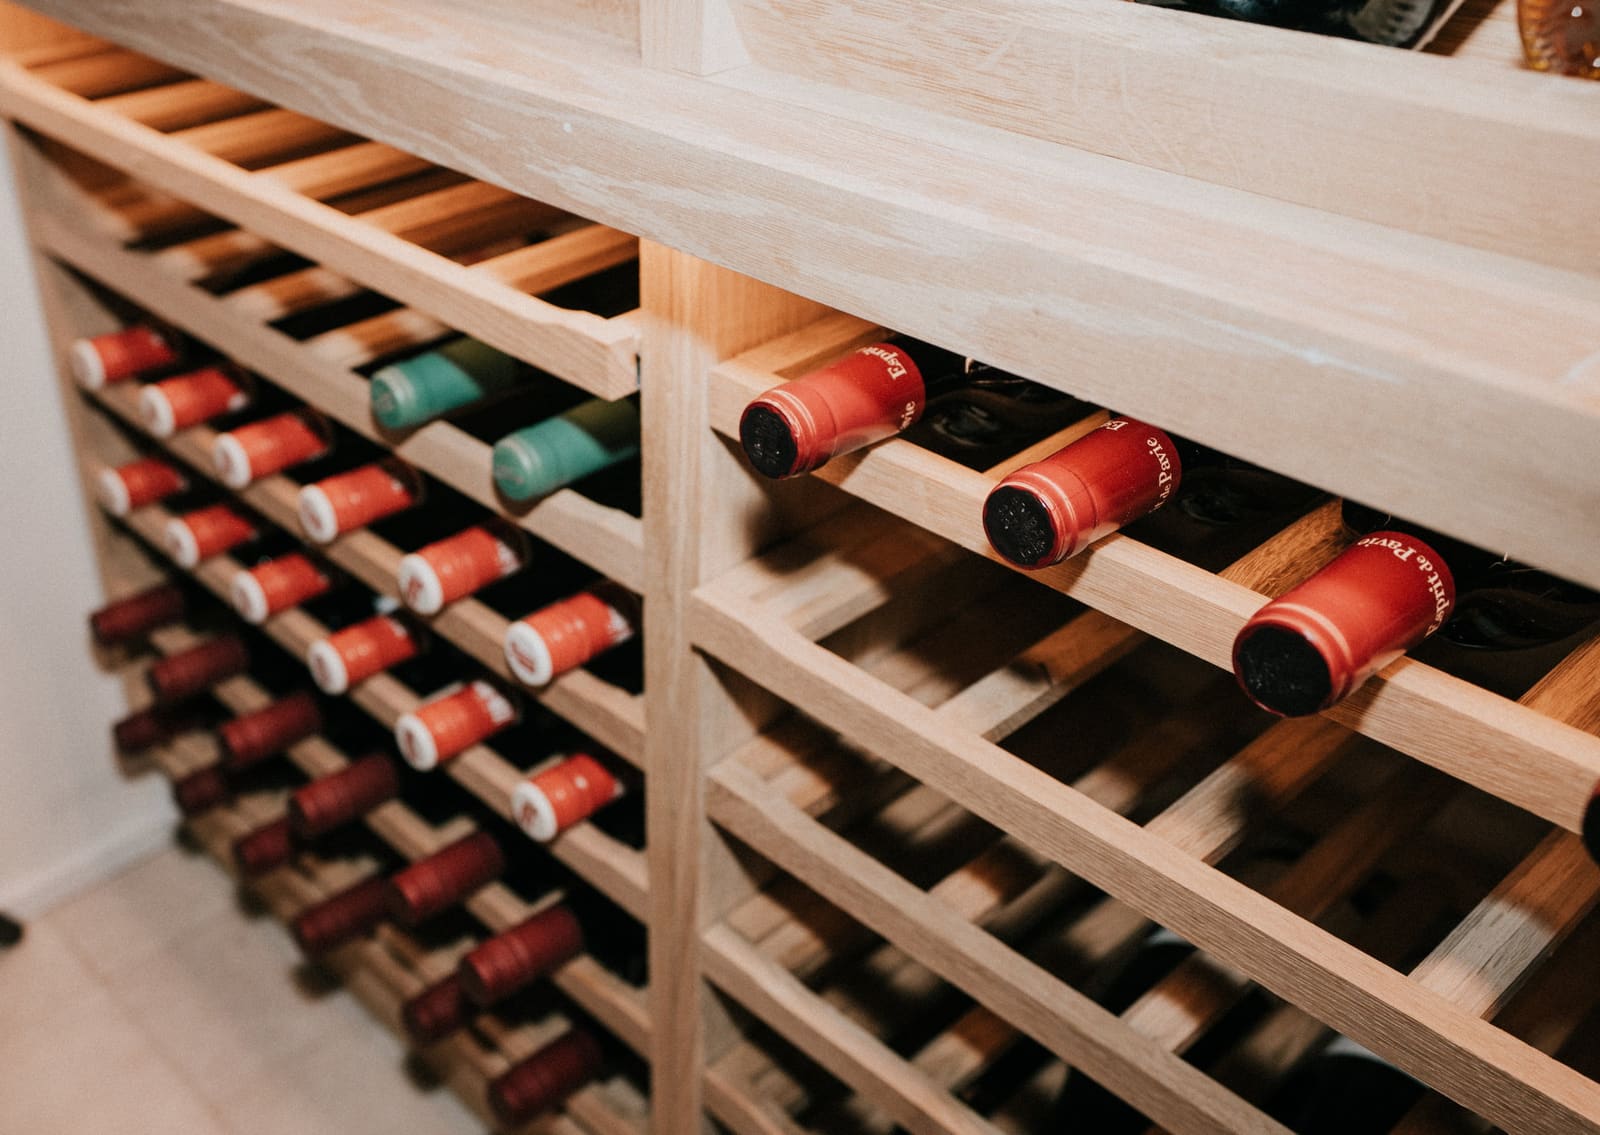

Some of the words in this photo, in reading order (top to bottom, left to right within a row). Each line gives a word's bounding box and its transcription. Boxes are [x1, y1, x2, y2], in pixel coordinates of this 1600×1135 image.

[1146, 436, 1173, 487] Pavie
[1357, 537, 1417, 562] Pavie
[1416, 555, 1433, 571] de
[1424, 571, 1450, 638] Esprit
